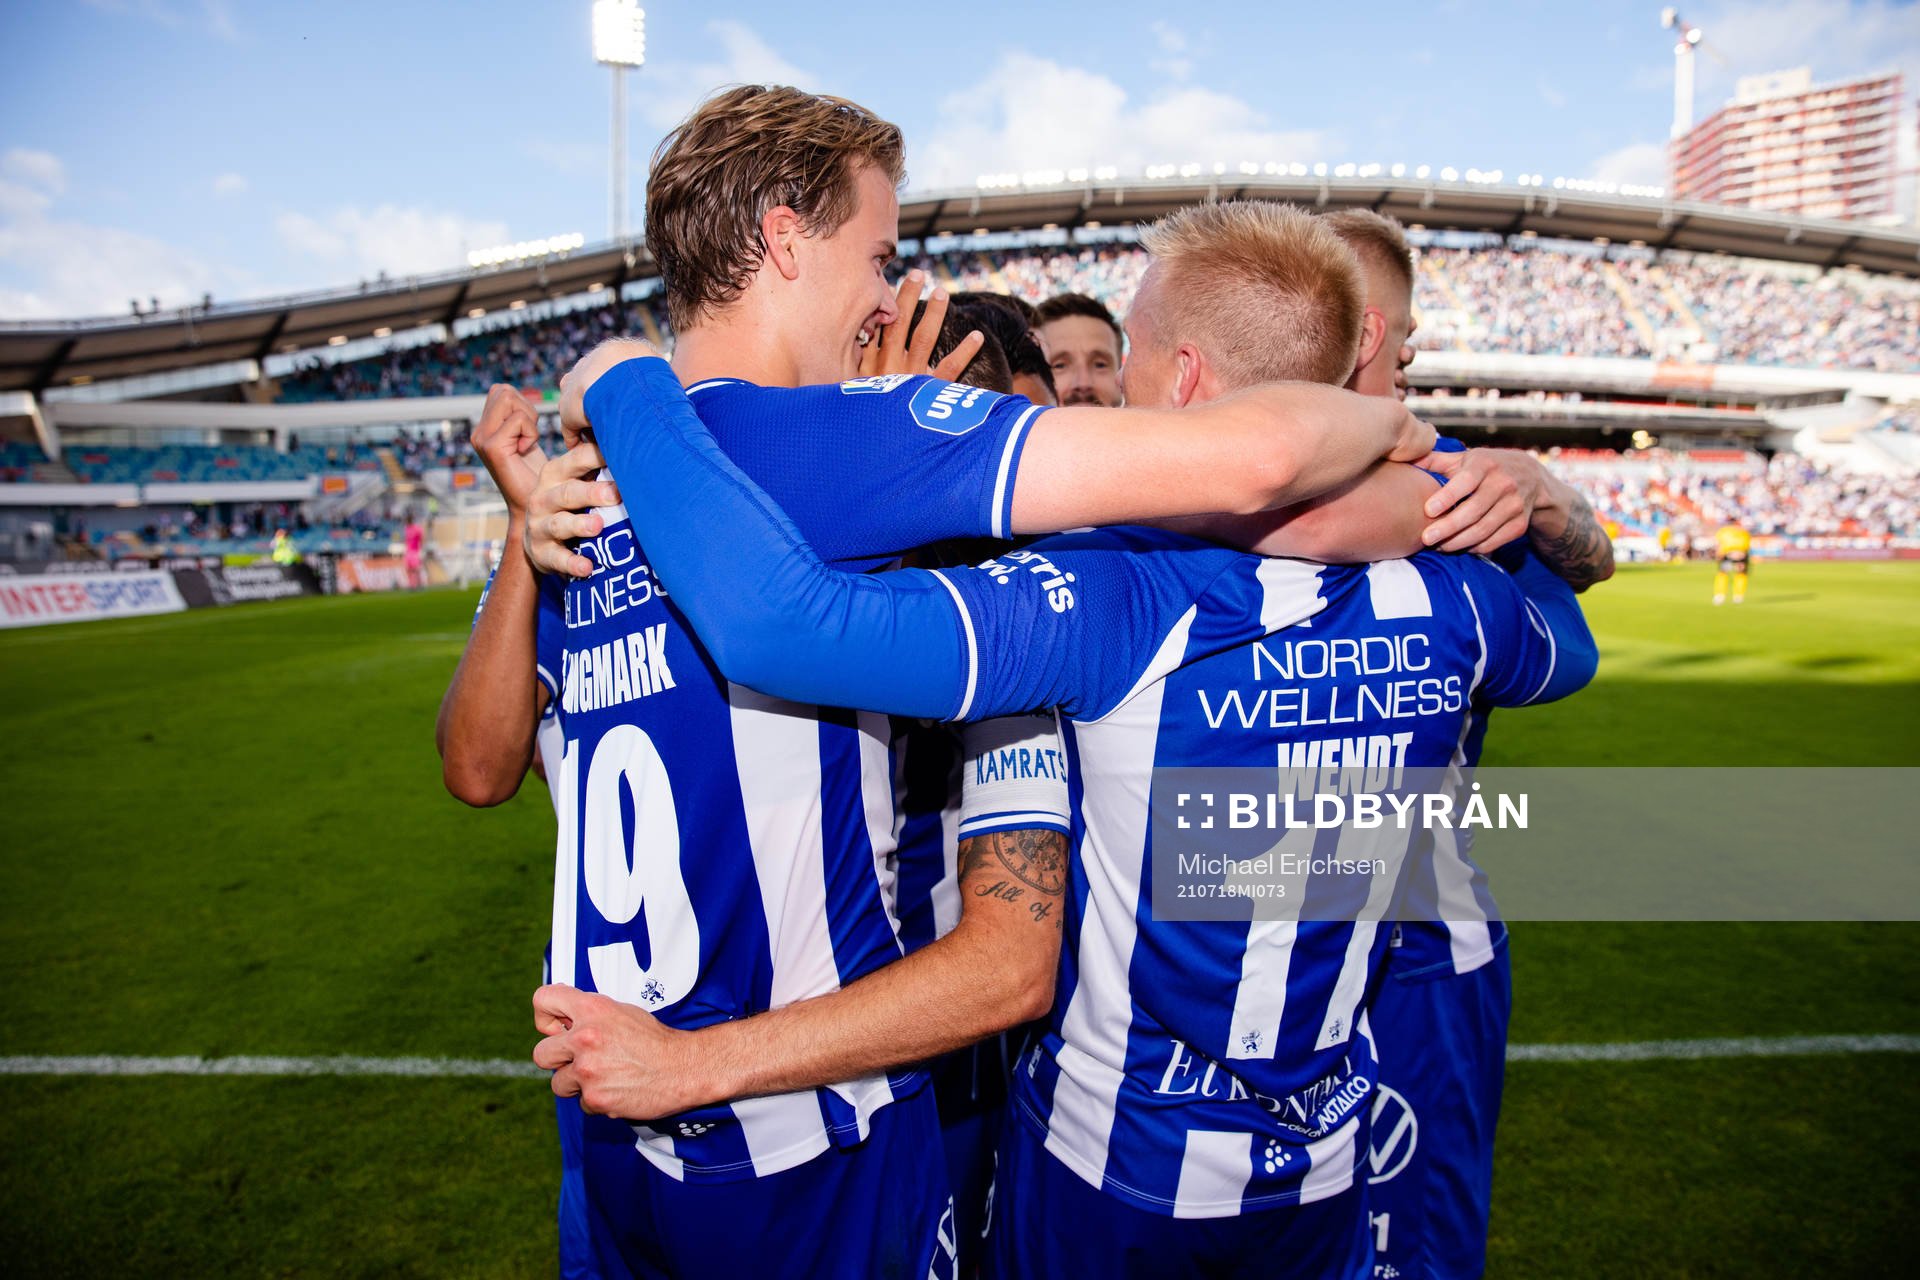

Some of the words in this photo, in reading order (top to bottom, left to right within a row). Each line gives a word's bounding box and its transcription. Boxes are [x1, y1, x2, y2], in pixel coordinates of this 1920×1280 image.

[1004, 550, 1076, 613] orris
[1252, 633, 1432, 681] NORDIC
[1198, 676, 1462, 729] WELLNESS
[1277, 731, 1414, 804] WENDT
[551, 723, 700, 1013] 19
